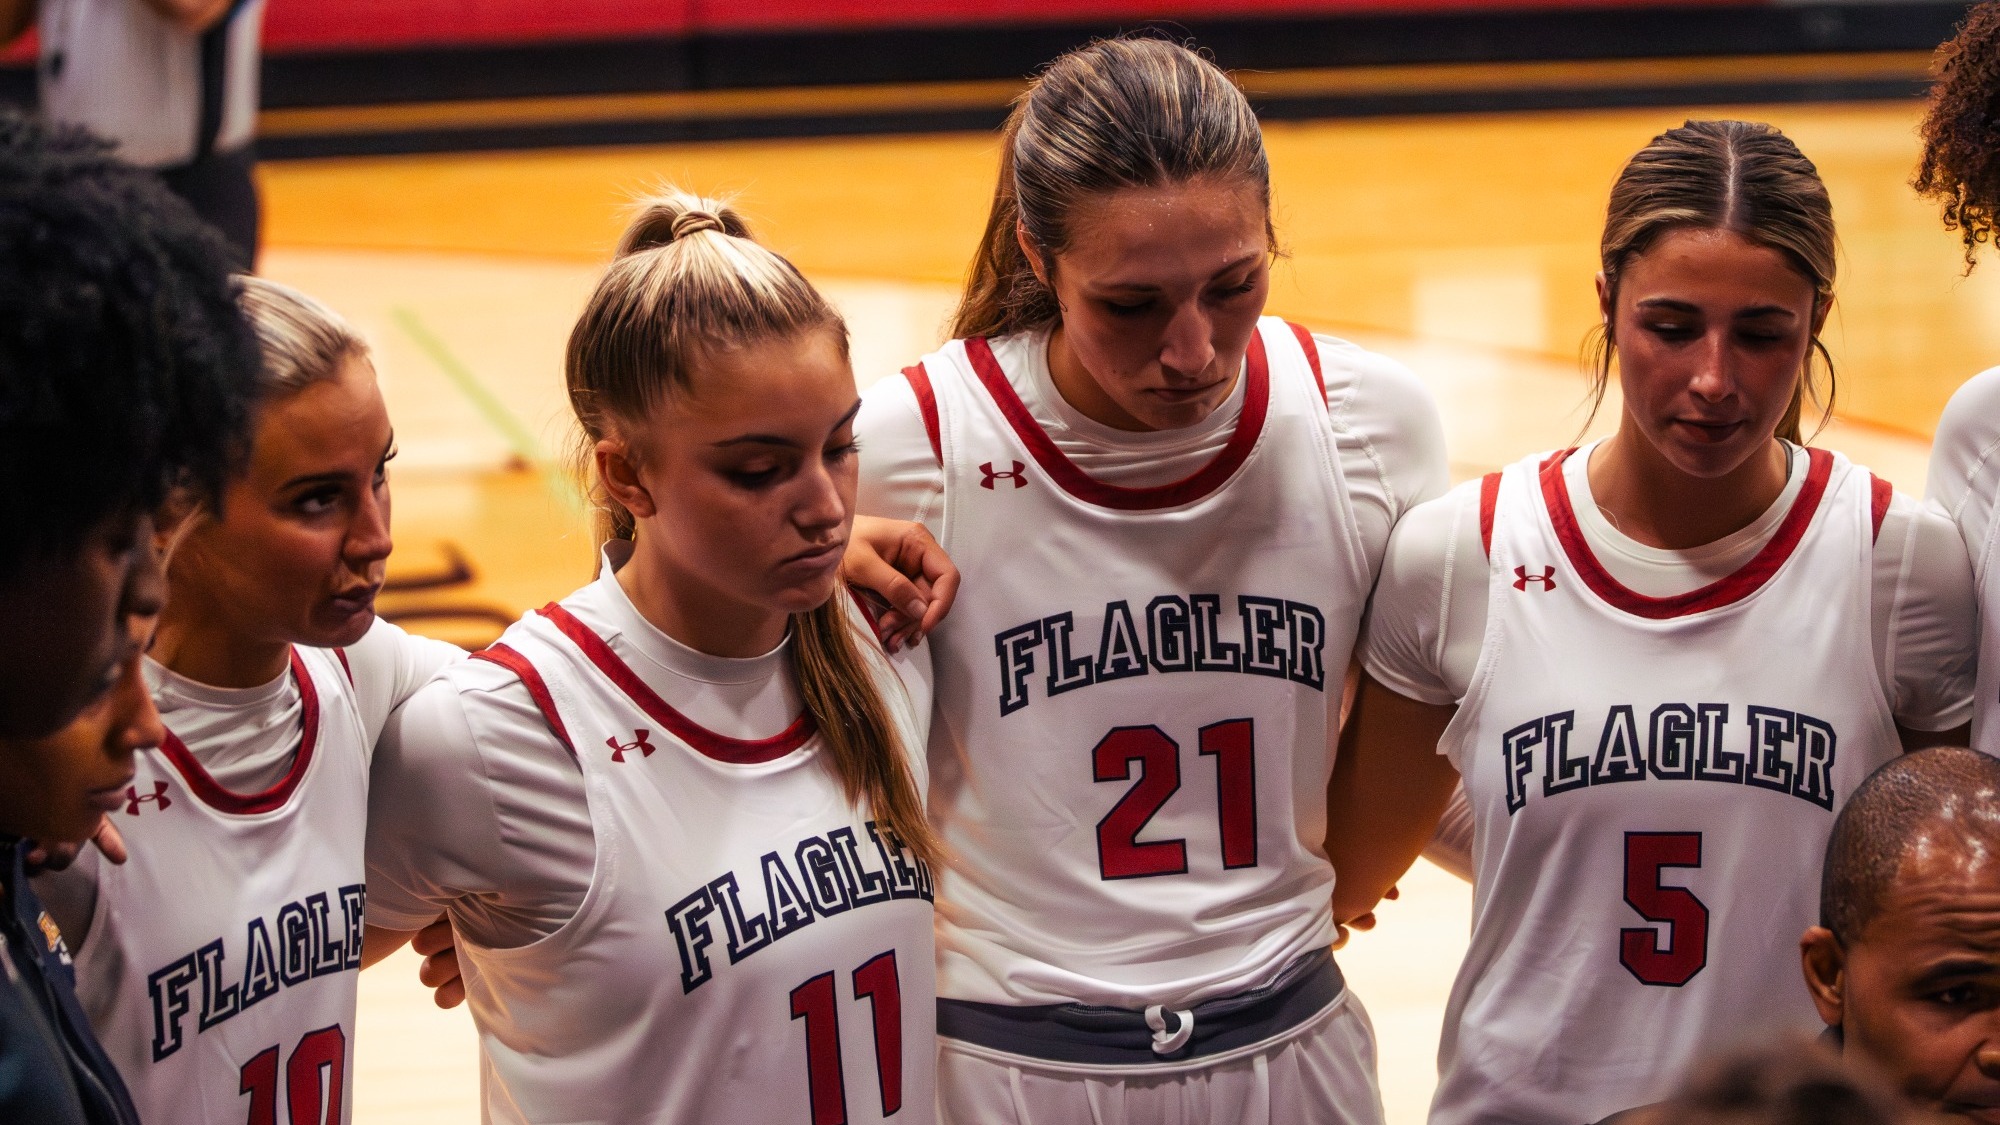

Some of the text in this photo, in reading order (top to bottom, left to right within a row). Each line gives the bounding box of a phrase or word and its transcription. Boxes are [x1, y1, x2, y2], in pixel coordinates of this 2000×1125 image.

[994, 594, 1326, 717] FLAGLER
[1092, 717, 1258, 881] 21
[1502, 703, 1837, 816] FLAGLER
[148, 883, 366, 1063] FLAGLE
[1619, 831, 1709, 987] 5
[239, 1023, 346, 1125] 10
[789, 948, 902, 1125] 11
